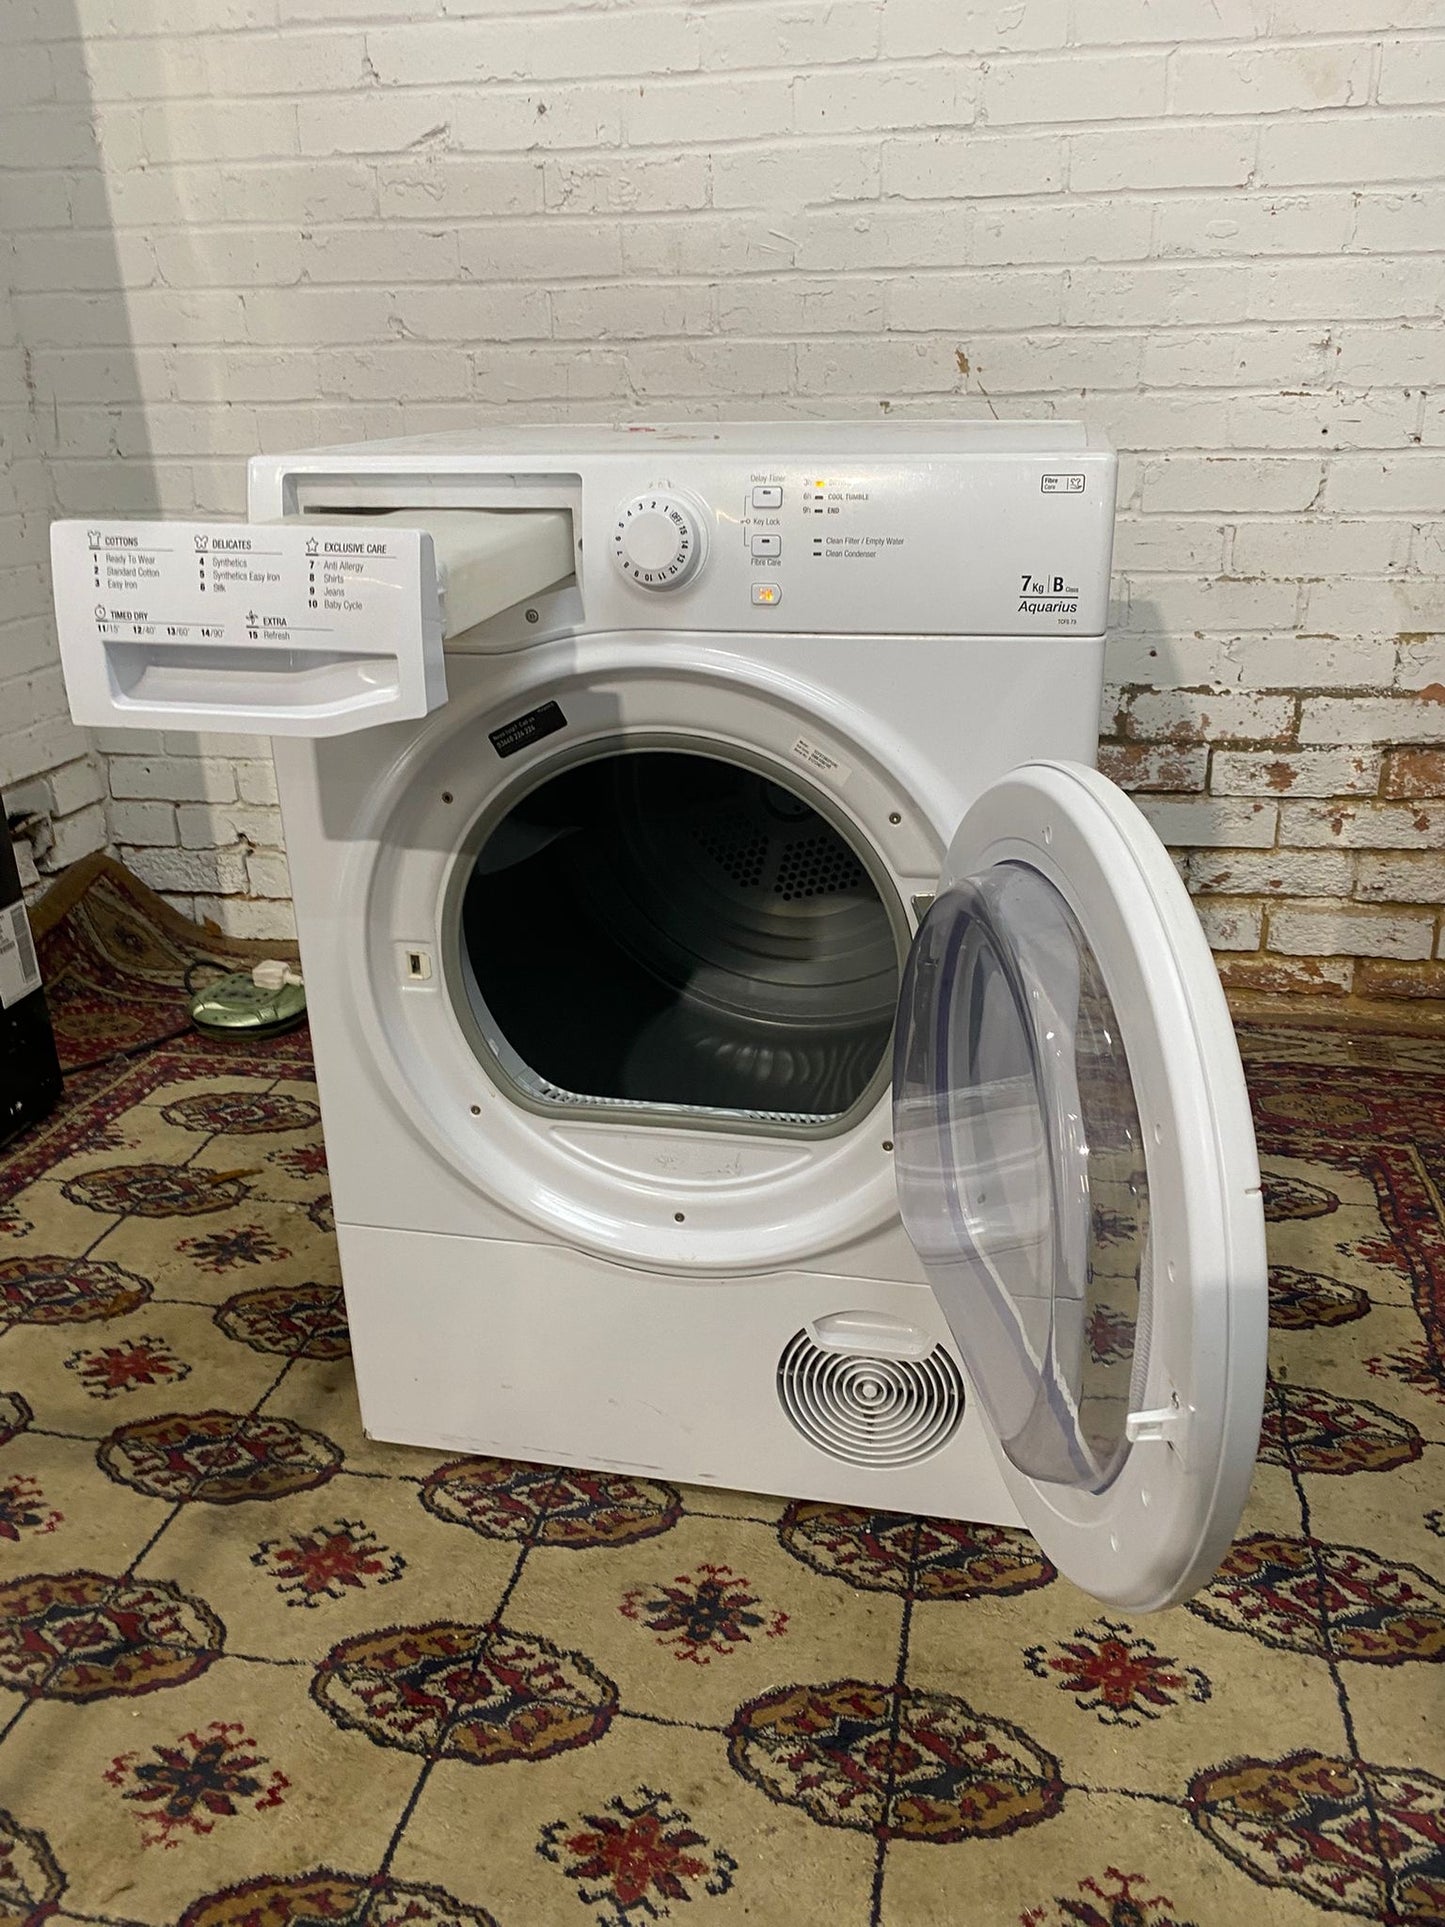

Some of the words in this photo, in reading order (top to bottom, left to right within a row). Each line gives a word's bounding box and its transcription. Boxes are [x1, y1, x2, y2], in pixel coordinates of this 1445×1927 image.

[750, 474, 767, 482] Delay
[679, 526, 687, 535] 15
[105, 536, 138, 546] COTTONS
[212, 539, 251, 550] DELICATES
[681, 540, 688, 549] 14
[865, 537, 884, 546] Empty
[324, 542, 364, 553] EXCLUSIVE
[367, 544, 387, 554] CARE
[94, 552, 97, 562] 1
[106, 553, 126, 564] Ready
[128, 554, 136, 564] To
[138, 555, 155, 564] Wear
[200, 557, 204, 566] 4
[212, 557, 247, 568] Synthetics
[677, 553, 685, 563] 13
[94, 566, 99, 575] 2
[107, 566, 136, 577] Standard
[138, 567, 160, 577] Cotton
[310, 560, 314, 569] 7
[324, 561, 337, 571] Anti
[339, 561, 364, 573] Allergy
[669, 565, 678, 574] 12
[200, 570, 205, 578] 5
[213, 570, 247, 581] Synthetics
[249, 571, 265, 583] Easy
[267, 572, 281, 581] Iron
[310, 573, 314, 582] 8
[324, 574, 344, 584] Shirts
[95, 579, 100, 587] 3
[108, 579, 123, 589] Easy
[124, 580, 138, 589] Iron
[200, 583, 205, 591] 6
[213, 583, 226, 592] Silk
[1022, 576, 1032, 591] 7
[1033, 582, 1044, 594] Kg
[1054, 577, 1064, 592] B
[310, 586, 315, 596] 9
[324, 587, 345, 597] Jeans
[308, 599, 318, 608] 10
[324, 600, 342, 611] Baby
[343, 600, 362, 611] Cycle
[1018, 600, 1077, 614] Aquarius
[111, 611, 132, 620] TIMED
[134, 612, 148, 621] DRY
[263, 617, 287, 626] EXTRA
[249, 631, 258, 640] 15
[264, 631, 290, 640] Refresh
